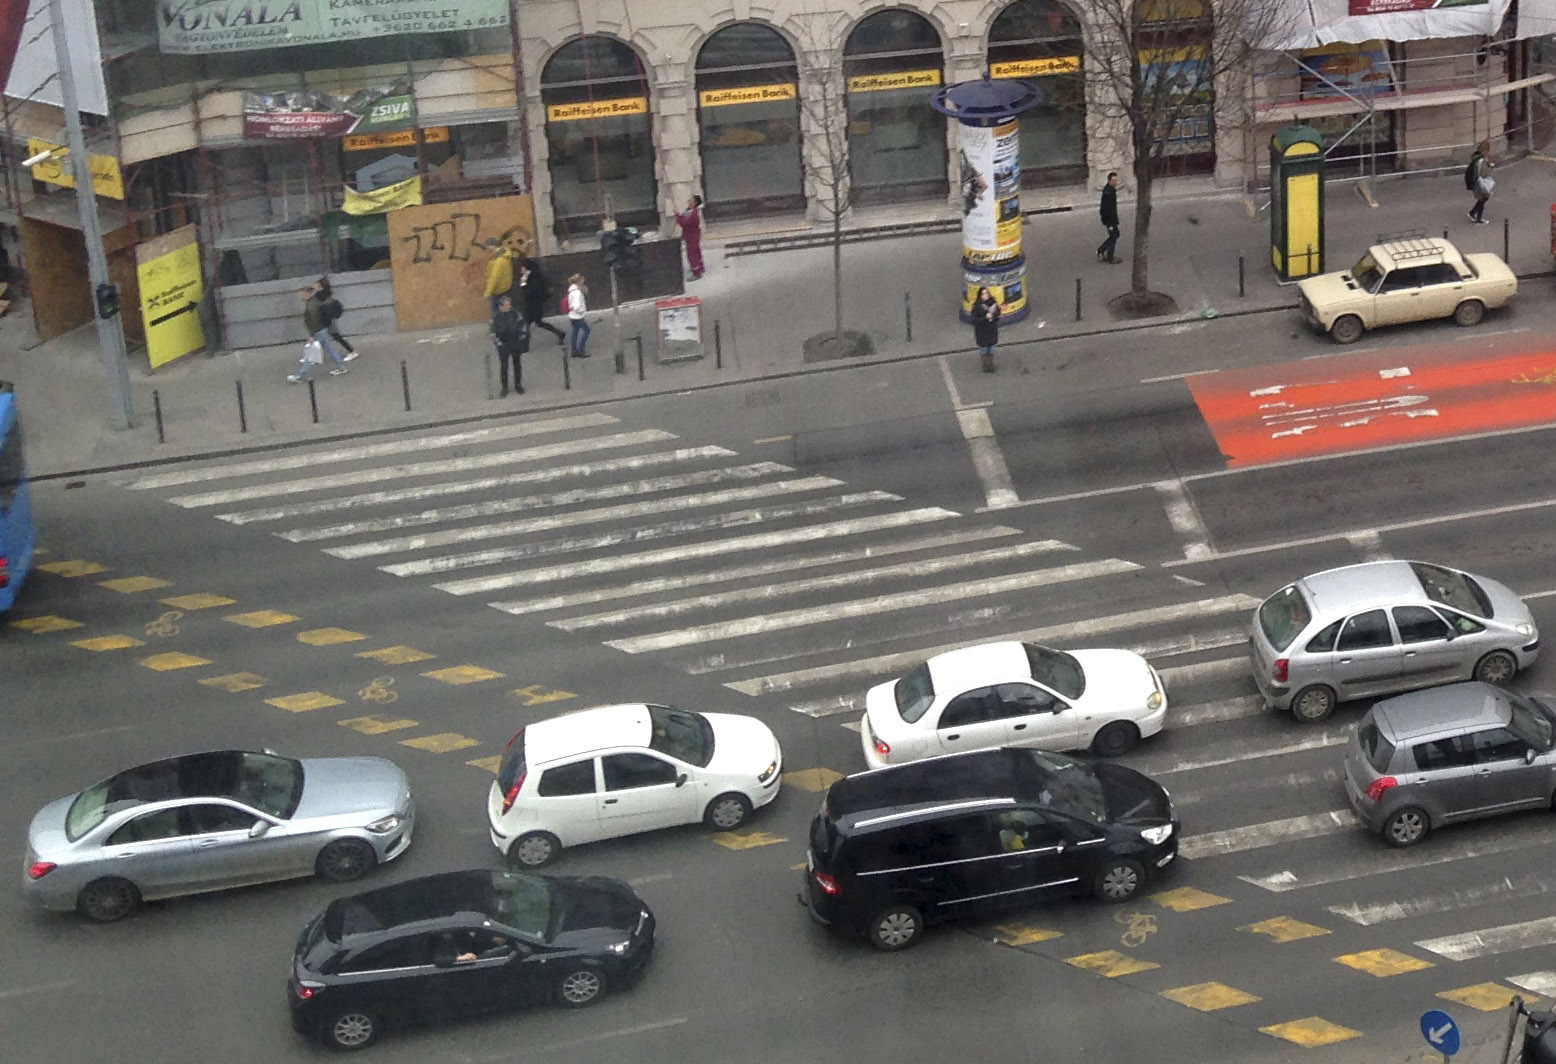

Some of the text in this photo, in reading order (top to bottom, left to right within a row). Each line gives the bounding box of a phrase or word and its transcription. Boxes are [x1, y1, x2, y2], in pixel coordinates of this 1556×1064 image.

[852, 74, 934, 88] Raiffeisen Bank
[706, 88, 790, 102] Raiffeisen Bank
[371, 102, 410, 117] ZSIVA
[553, 101, 641, 118] Raiffeisen Bank
